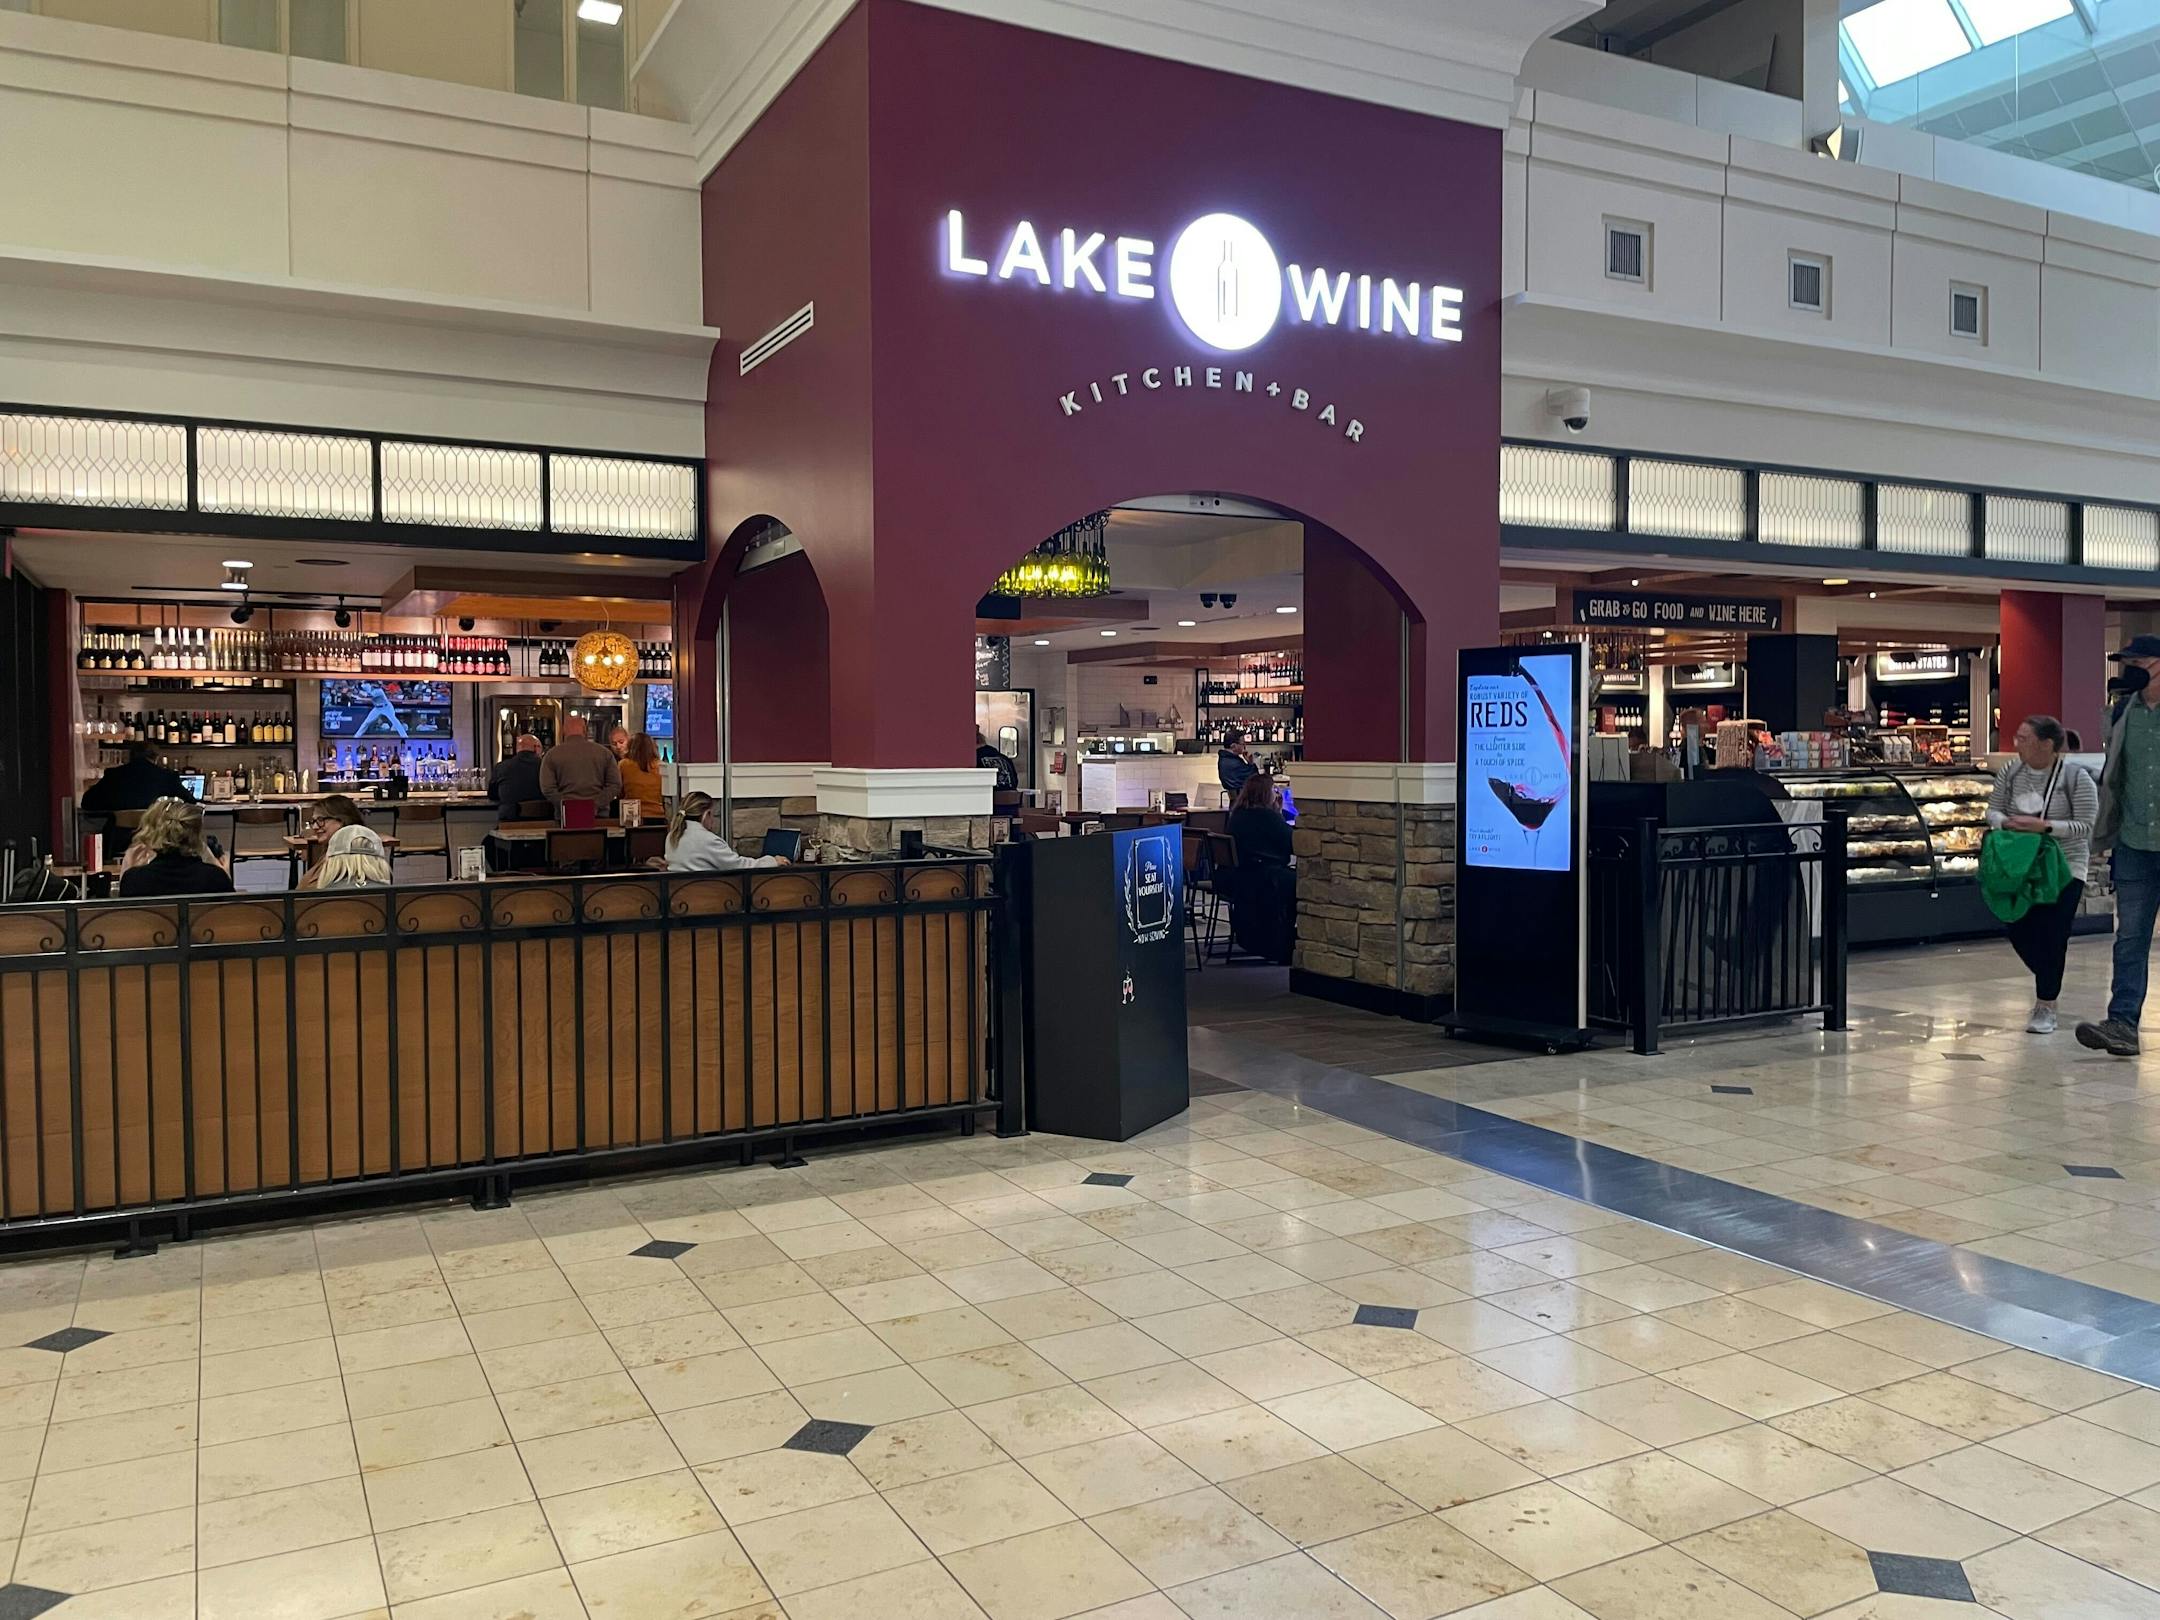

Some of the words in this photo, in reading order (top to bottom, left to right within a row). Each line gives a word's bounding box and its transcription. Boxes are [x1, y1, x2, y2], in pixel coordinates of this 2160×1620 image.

[947, 209, 1155, 299] LAKE
[1287, 263, 1464, 342] WINE
[1590, 599, 1620, 617] GRAB
[1632, 601, 1647, 619] GO
[1654, 602, 1684, 620] FOOD
[1690, 607, 1704, 618] AND
[1708, 604, 1736, 622] WINE
[1739, 606, 1766, 623] HERE
[1471, 701, 1528, 728] REDS
[1145, 872, 1157, 884] SEAT
[1138, 883, 1163, 896] YOURSELF
[1138, 933, 1149, 944] NOW
